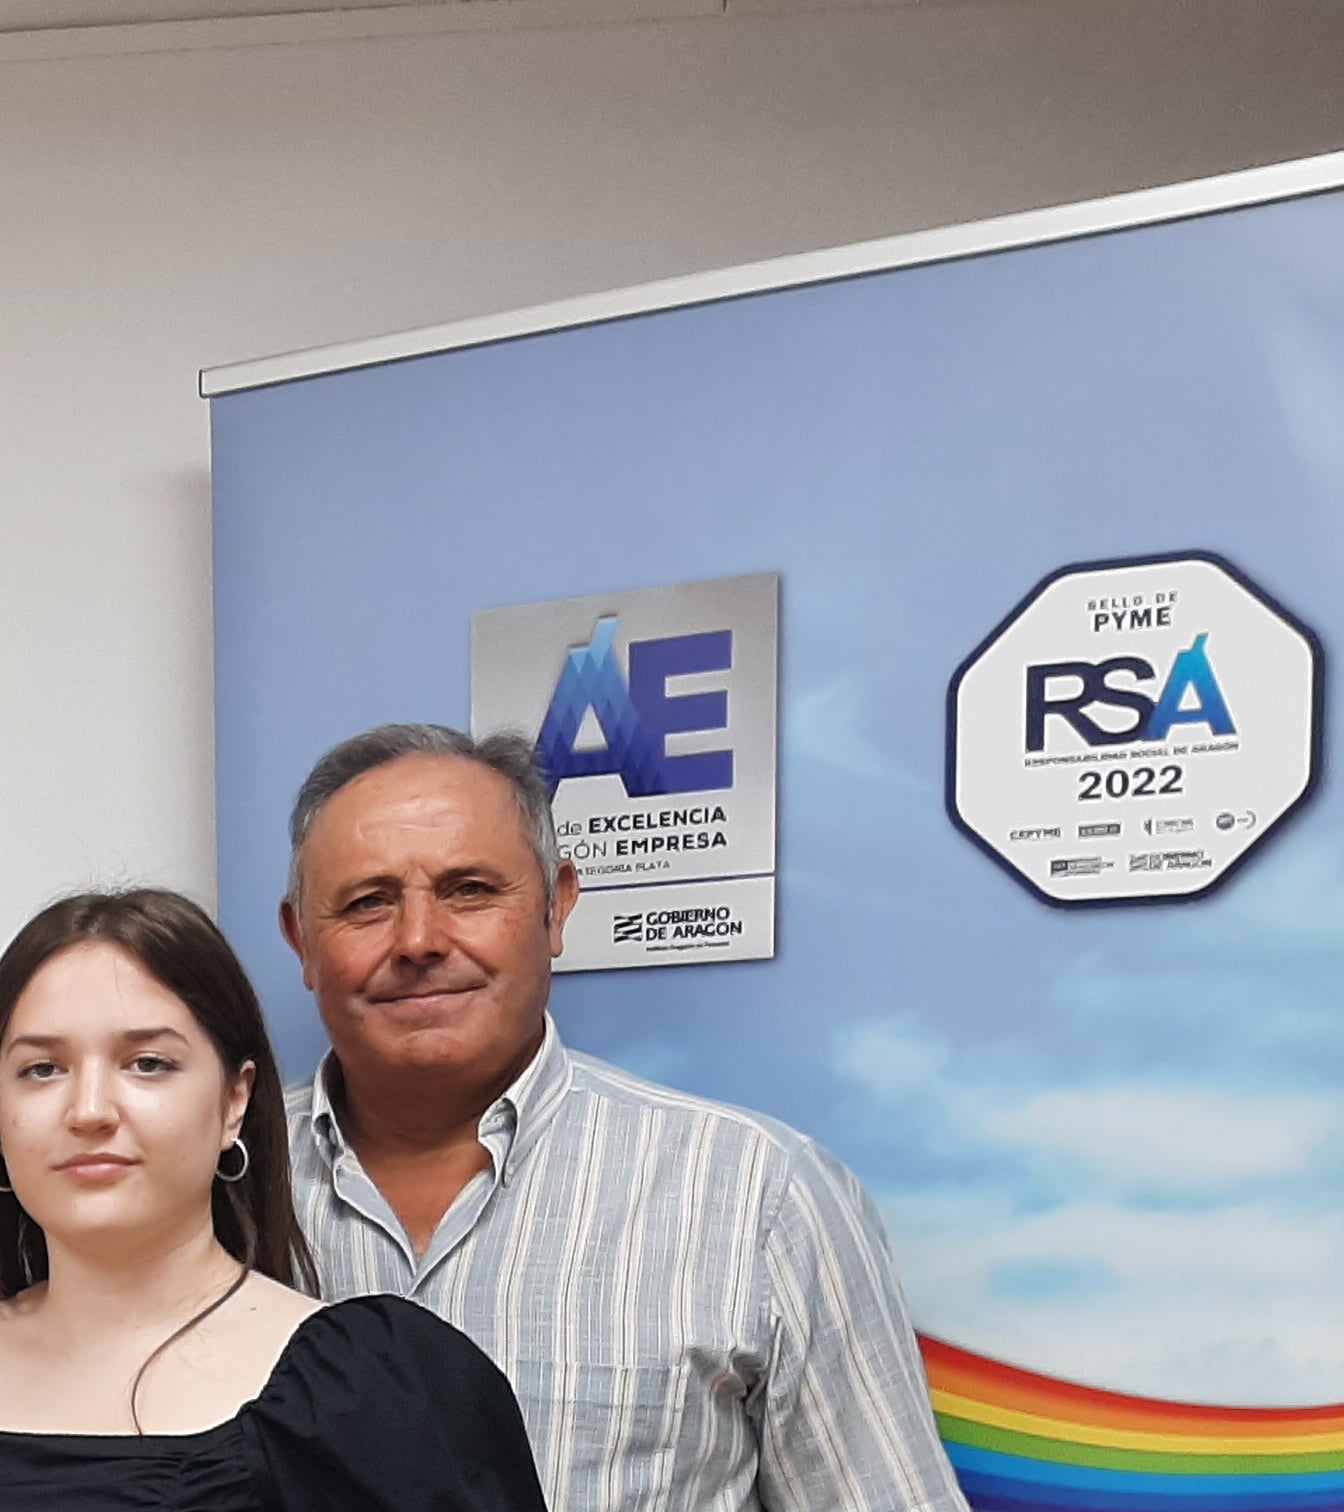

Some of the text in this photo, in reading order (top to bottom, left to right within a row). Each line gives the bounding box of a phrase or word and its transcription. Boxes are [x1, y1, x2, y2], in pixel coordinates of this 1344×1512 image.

[1094, 606, 1171, 632] PYME
[1078, 764, 1183, 801] 2022
[557, 806, 727, 836] de EXCELENCIA
[557, 832, 727, 860] GÓN EMPRESA
[646, 907, 730, 926] GOBIERNO
[646, 928, 666, 942] DE
